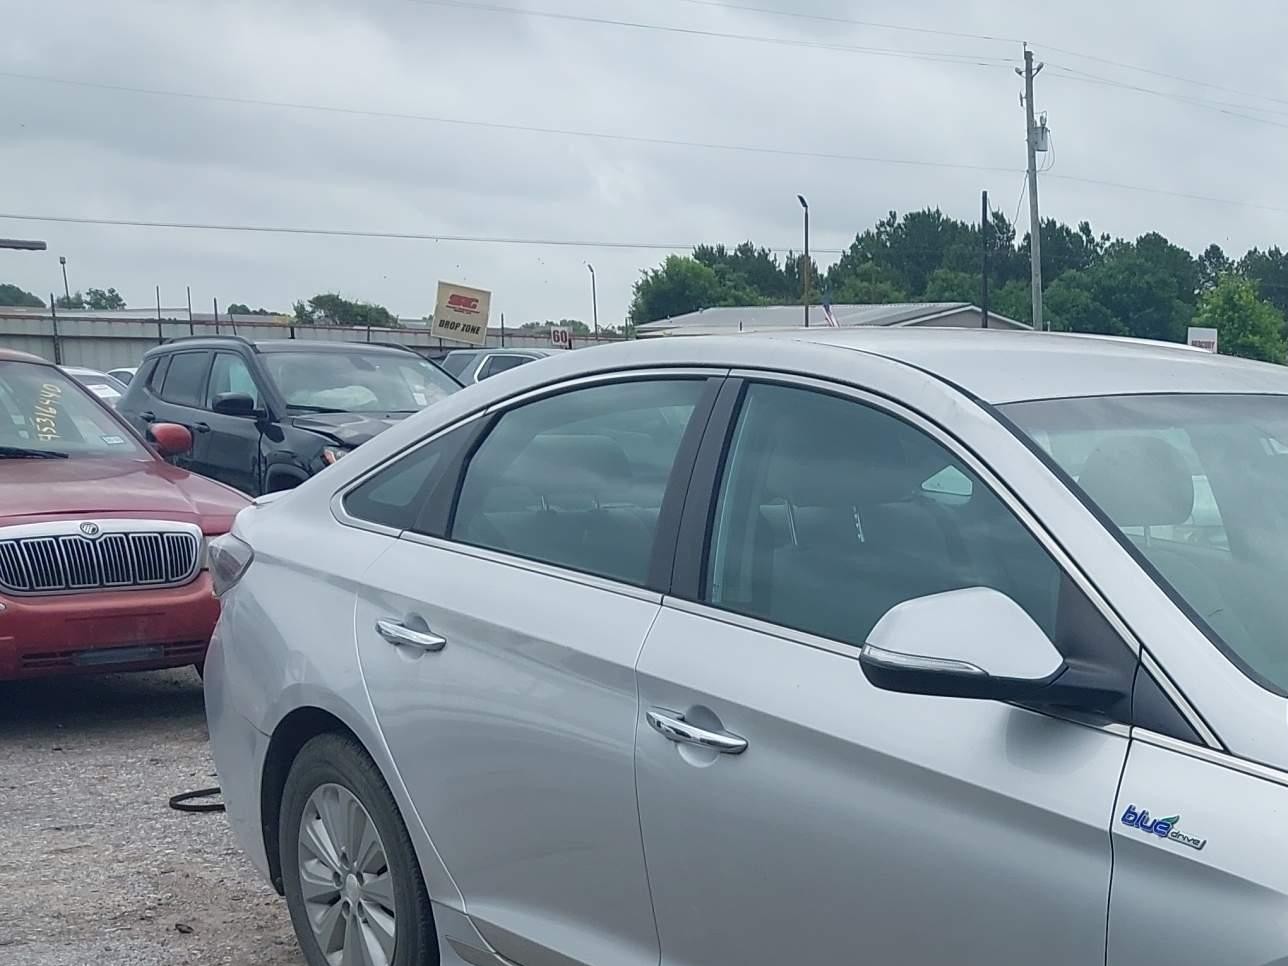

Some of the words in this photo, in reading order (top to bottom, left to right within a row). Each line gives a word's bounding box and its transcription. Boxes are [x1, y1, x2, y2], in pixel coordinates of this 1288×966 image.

[438, 319, 461, 331] DROP
[461, 324, 481, 335] ZONE
[552, 329, 568, 343] 60
[1121, 804, 1172, 838] blue
